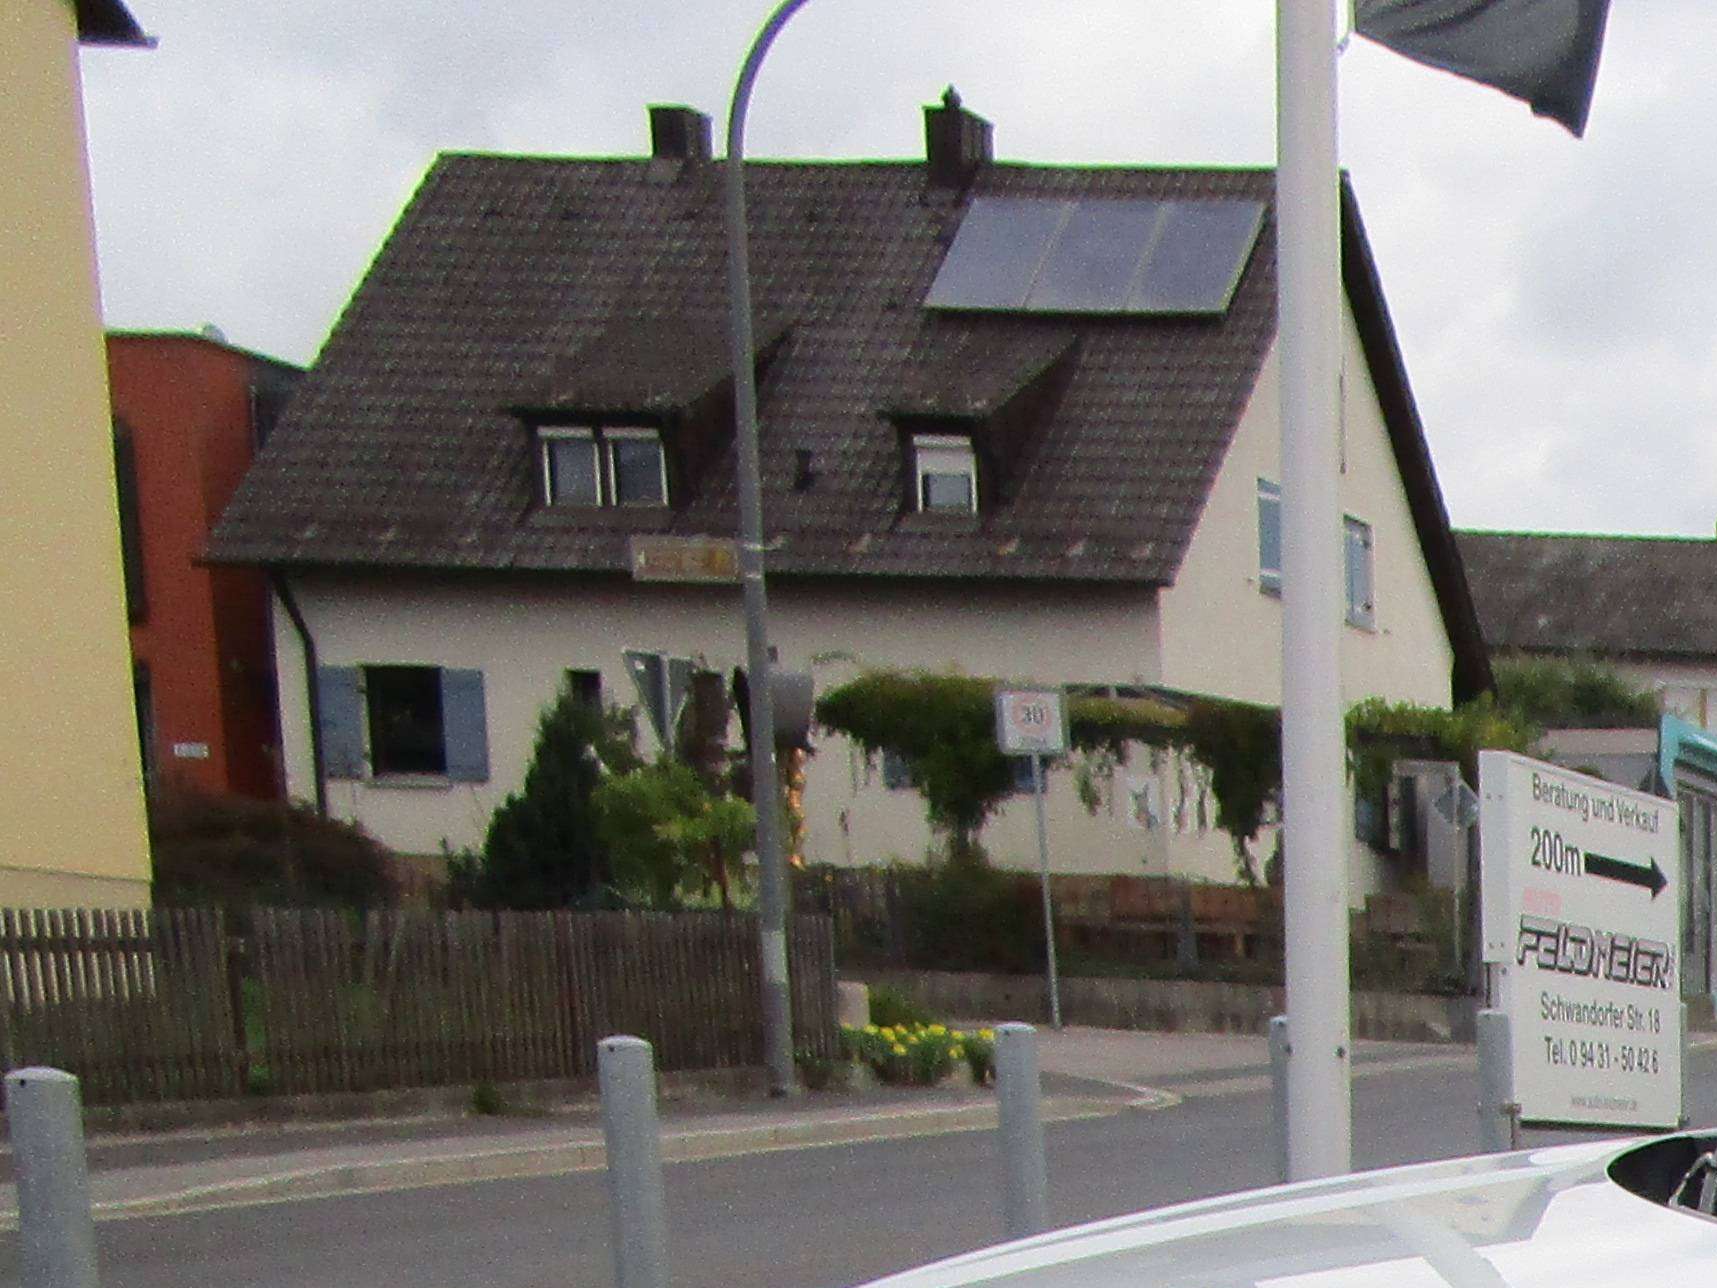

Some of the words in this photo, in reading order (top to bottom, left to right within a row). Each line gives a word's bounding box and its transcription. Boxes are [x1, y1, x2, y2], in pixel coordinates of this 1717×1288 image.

[1024, 704, 1043, 725] 30
[1532, 772, 1590, 822] Beratung
[1592, 795, 1614, 821] und
[1616, 798, 1659, 833] Verkauf
[1531, 825, 1581, 877] 200m
[1517, 914, 1671, 988] FELDMEIER
[1541, 991, 1624, 1029] Schwandorfer
[1649, 1008, 1660, 1034] 18
[1544, 1036, 1567, 1064] Tel.
